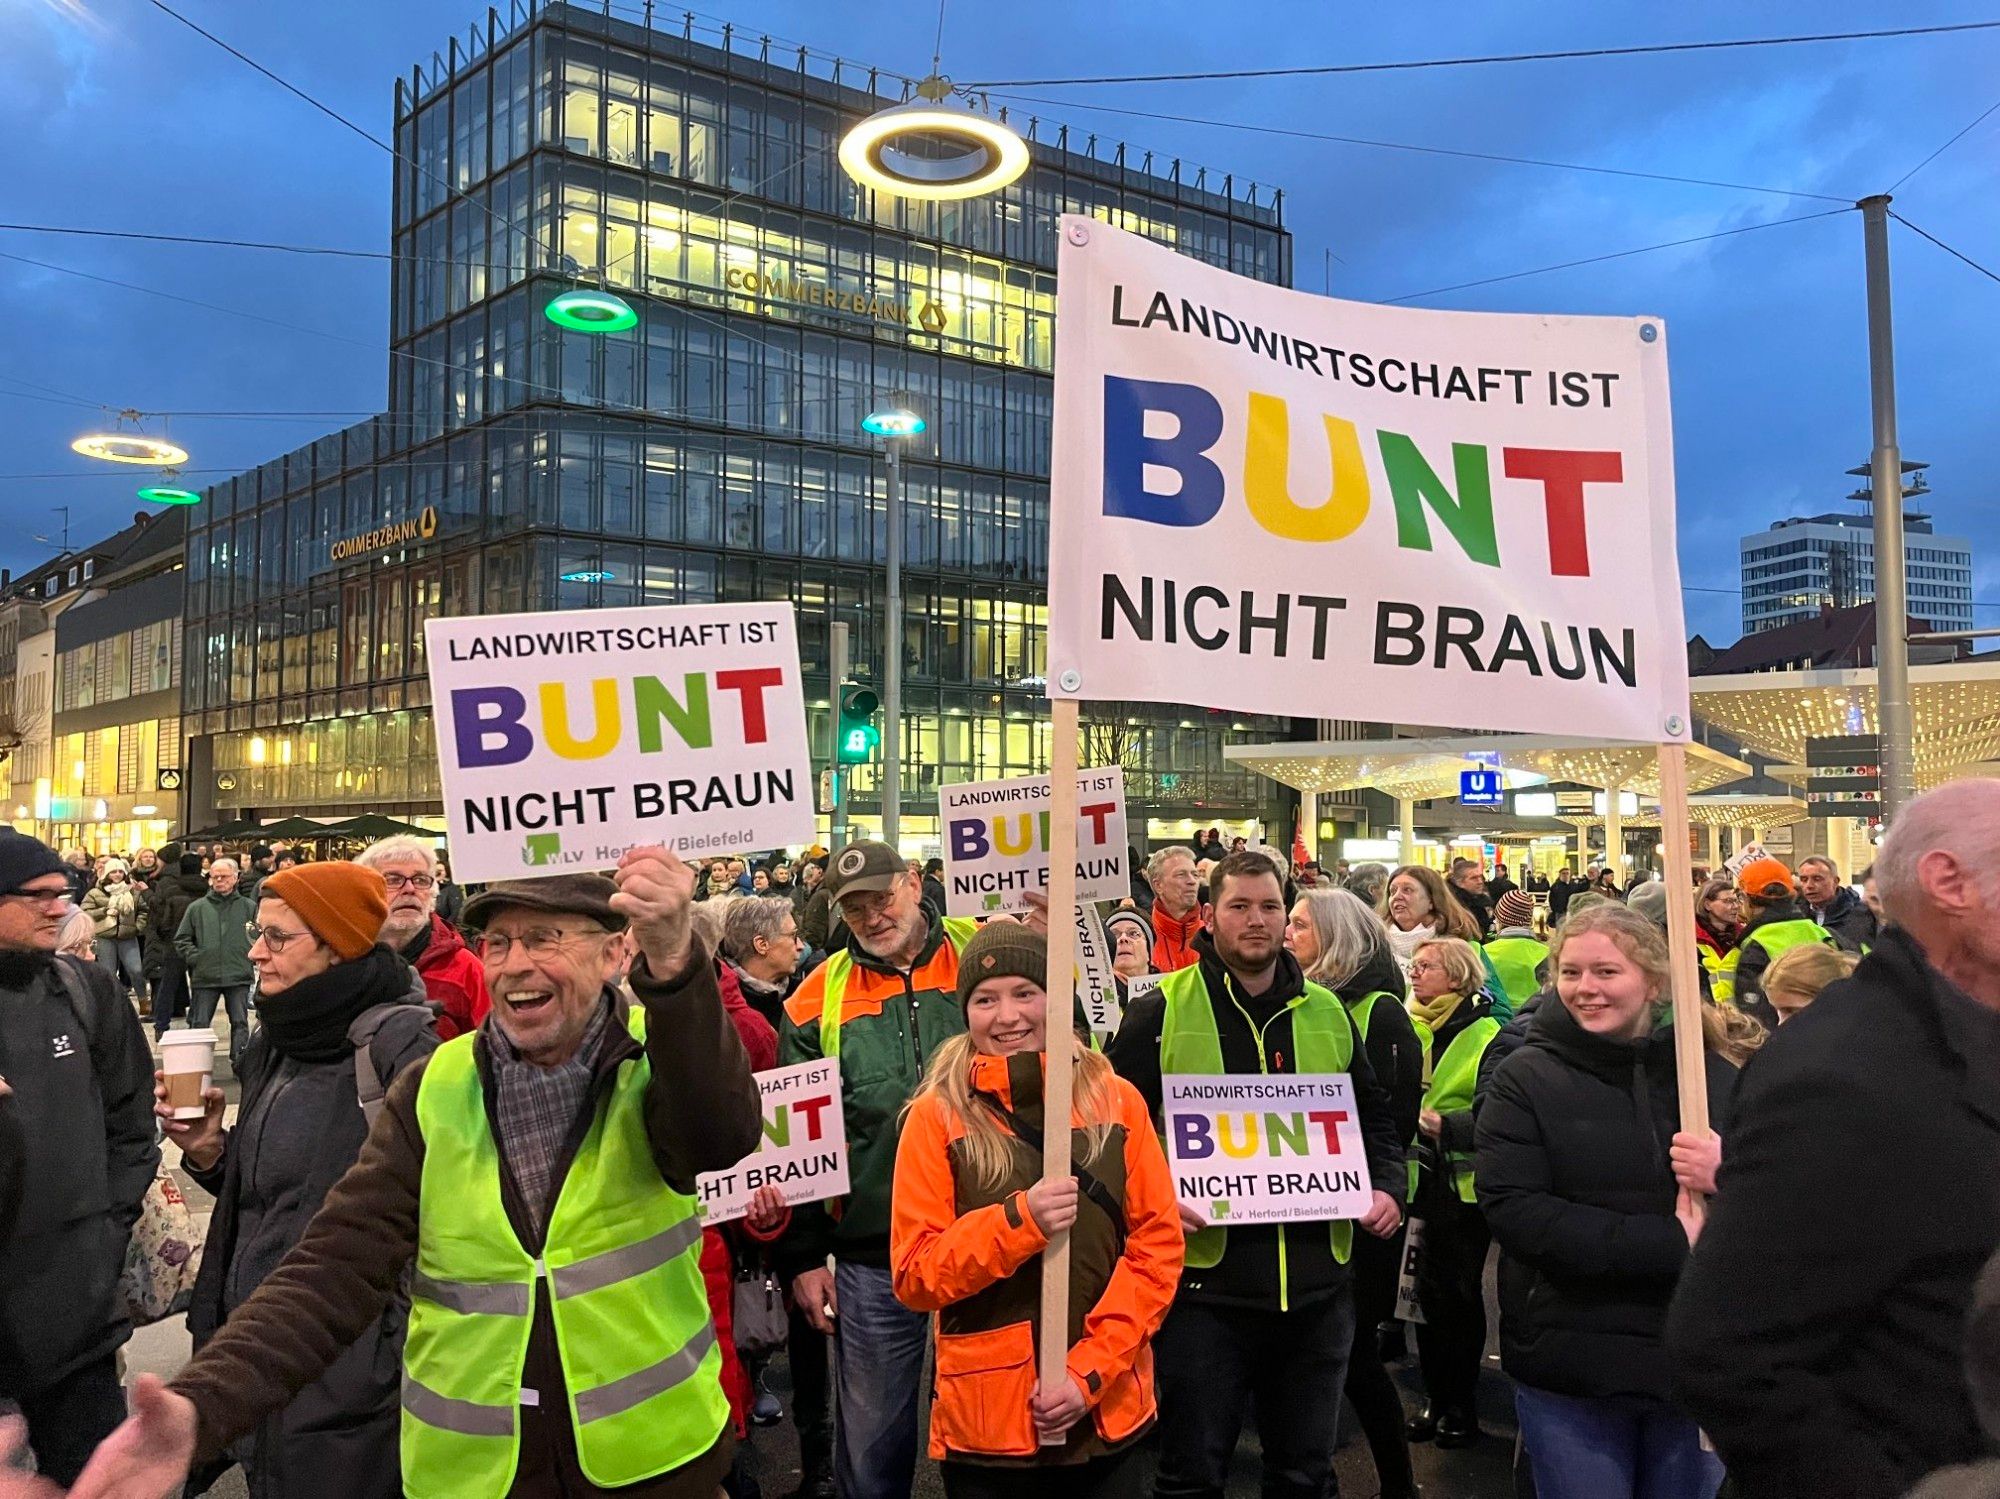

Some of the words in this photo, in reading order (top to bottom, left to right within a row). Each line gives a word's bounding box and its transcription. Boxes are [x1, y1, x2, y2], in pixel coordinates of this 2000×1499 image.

[726, 269, 912, 324] COMMERZBANK
[1112, 285, 1531, 404] LANDWIRTSCHAFT
[1549, 371, 1620, 408] IST
[1102, 374, 1624, 577] BUNT
[331, 518, 418, 560] COMMERZBANK
[449, 623, 731, 661] LANDWIRTSCHAFT
[741, 621, 778, 644] IST
[1101, 574, 1346, 661] NICHT
[1374, 601, 1638, 688] BRAUN
[450, 667, 783, 769] BUNT
[463, 786, 616, 835] NICHT
[633, 768, 795, 820] BRAUN
[949, 780, 1089, 807] LANDWIRTSCT
[1093, 777, 1114, 790] IST
[1470, 774, 1486, 791] U
[949, 802, 1116, 862] BUT
[954, 869, 1030, 895] NICHT
[1038, 857, 1120, 887] BAUN
[1075, 905, 1095, 958] BRAU
[1086, 964, 1105, 1024] NICHT
[759, 1074, 801, 1095] HAFT
[807, 1068, 830, 1086] IST
[1172, 1084, 1316, 1099] LANDWIRTSCHAFT
[1320, 1084, 1344, 1097] IST
[754, 1095, 832, 1153] NT
[1172, 1110, 1349, 1161] BUNT
[698, 1174, 737, 1202] HT
[746, 1152, 838, 1190] BRAUN
[1179, 1175, 1258, 1198] NICHT
[1267, 1171, 1361, 1195] BRAUN
